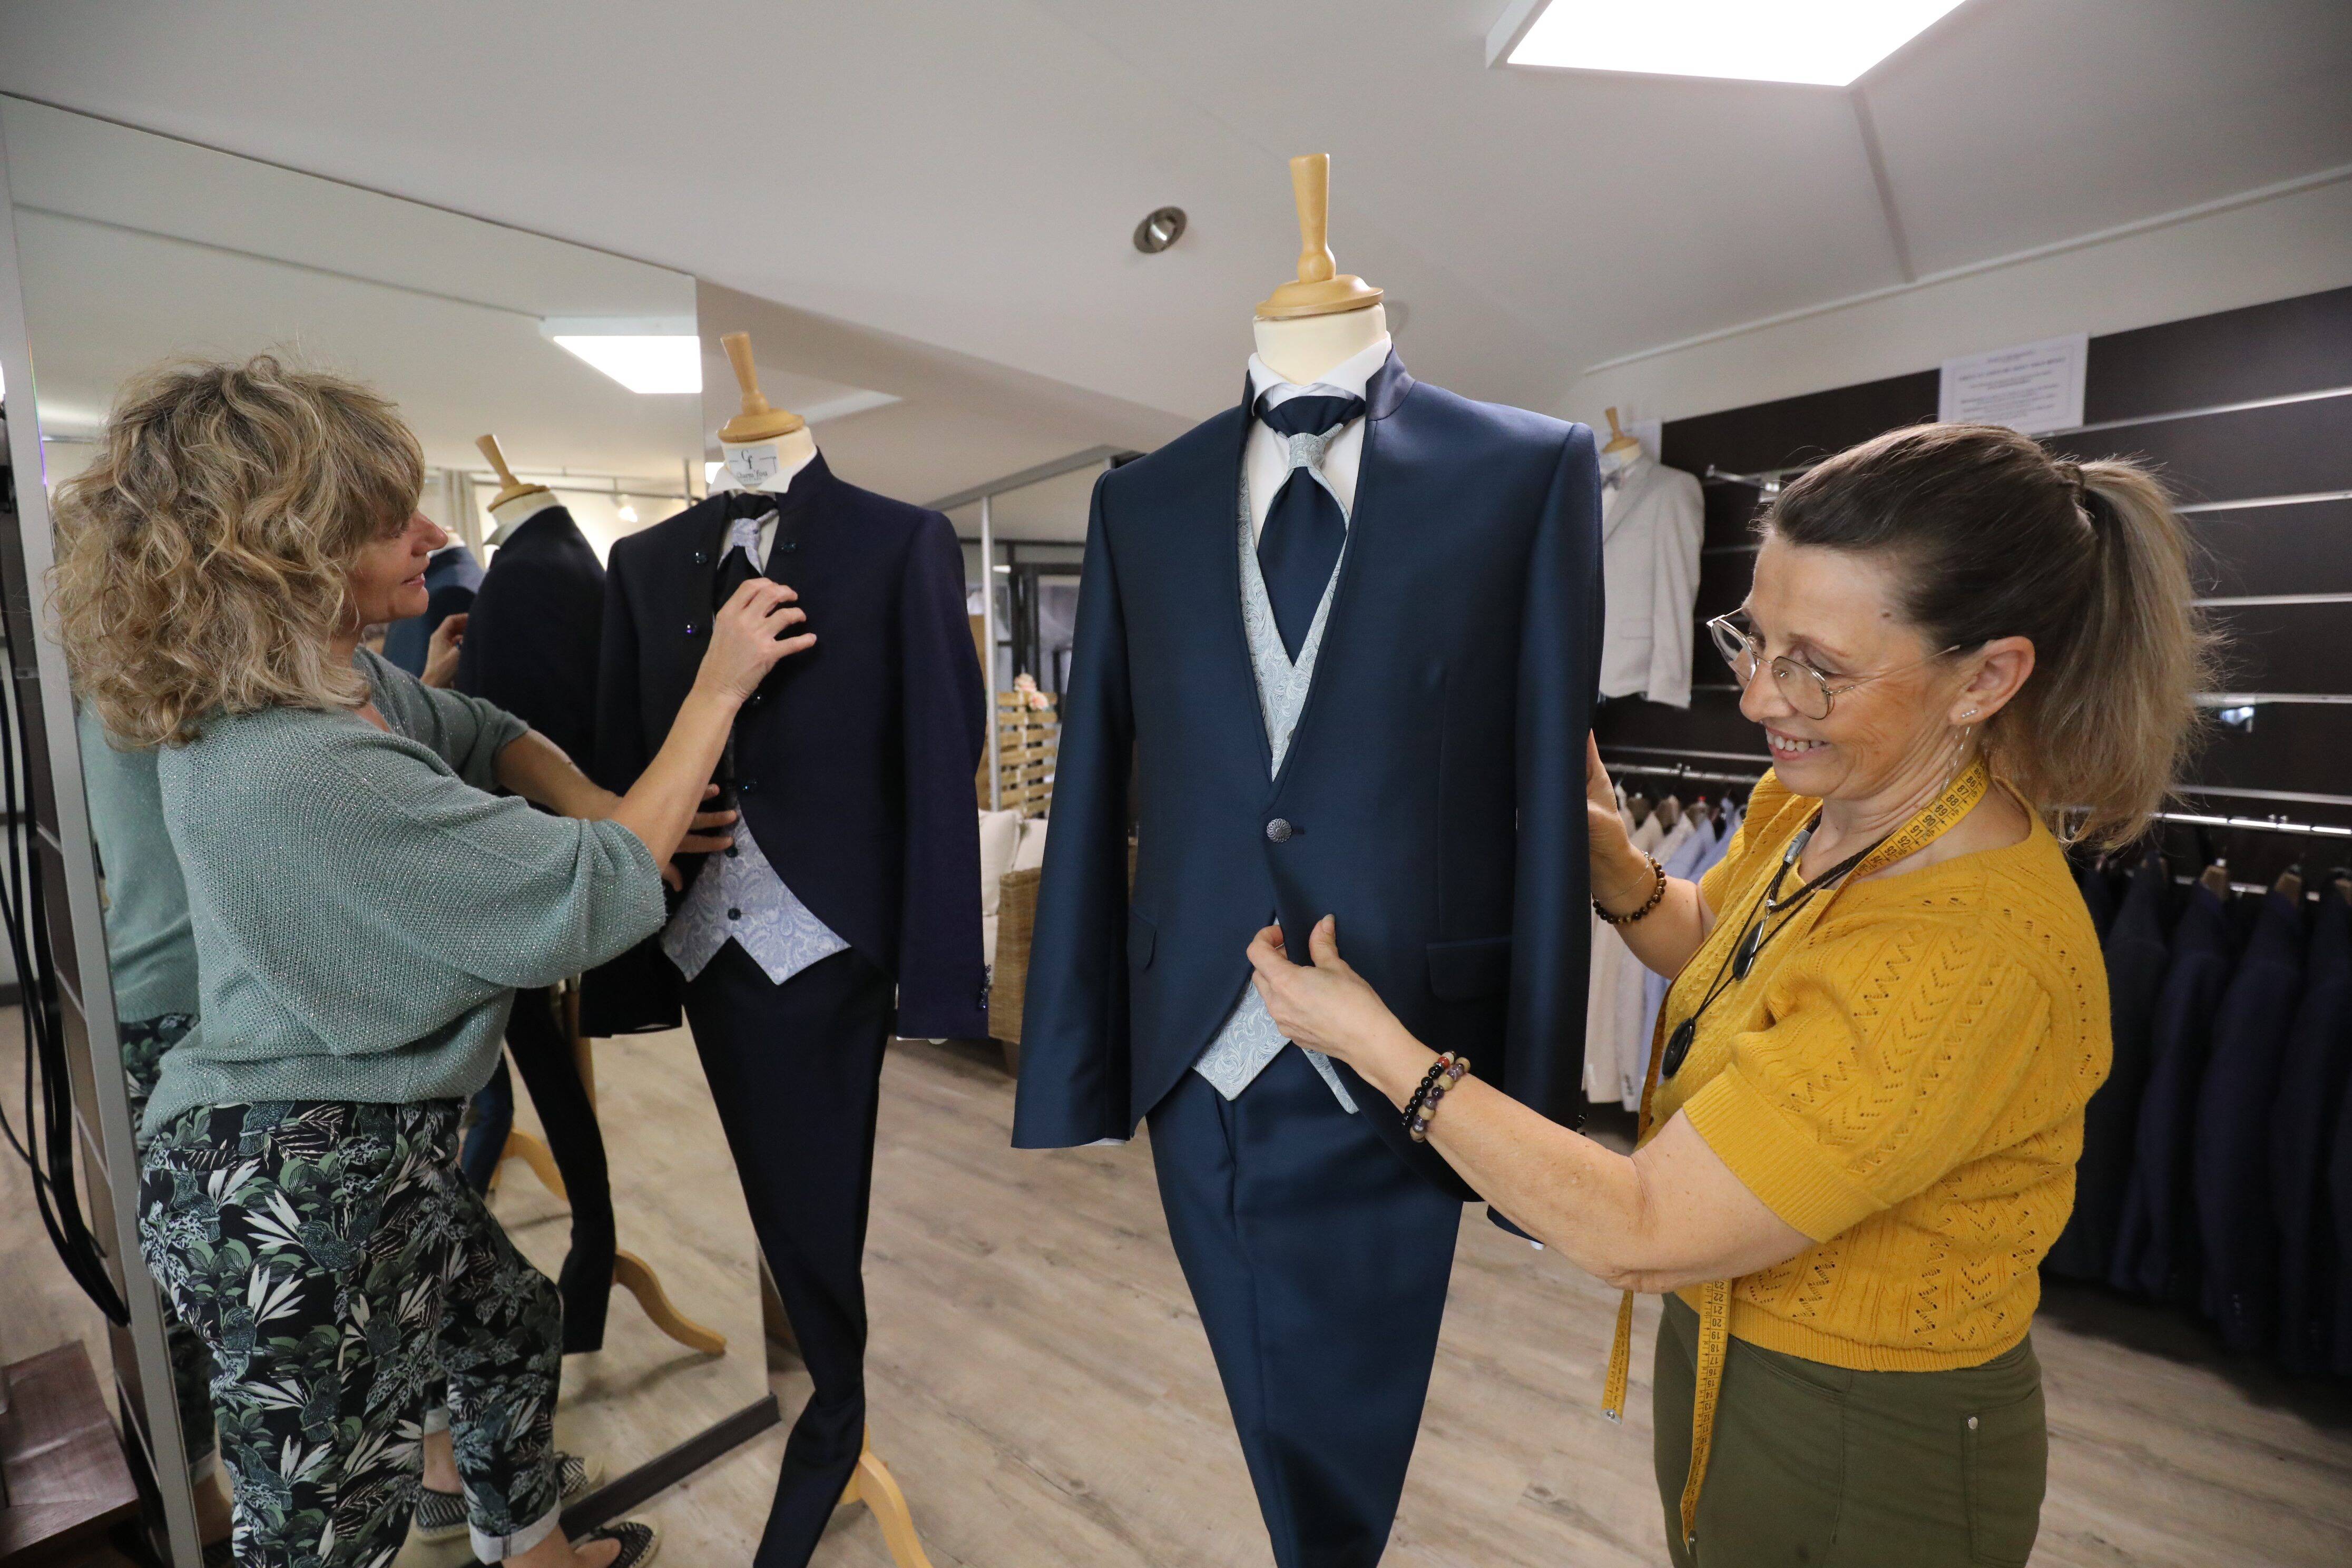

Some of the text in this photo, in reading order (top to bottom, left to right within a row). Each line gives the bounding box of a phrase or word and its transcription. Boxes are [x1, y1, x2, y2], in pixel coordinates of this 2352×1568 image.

[1974, 768, 1982, 779] 85
[1966, 776, 1977, 788] 86
[1957, 785, 1969, 796] 87
[1946, 794, 1959, 806] 88
[1935, 804, 1948, 817] 89
[1923, 815, 1936, 827] 90
[1910, 825, 1923, 837] 91
[1897, 836, 1910, 847] 92
[1884, 845, 1897, 857] 93
[1714, 1281, 1724, 1290] 23
[1713, 1292, 1723, 1302] 22
[1713, 1306, 1722, 1315] 21
[1712, 1318, 1722, 1327] 20
[1711, 1331, 1720, 1340] 19
[1710, 1344, 1720, 1353] 18
[1703, 1414, 1710, 1422] 12
[1702, 1425, 1708, 1433] 11
[1701, 1436, 1707, 1445] 10
